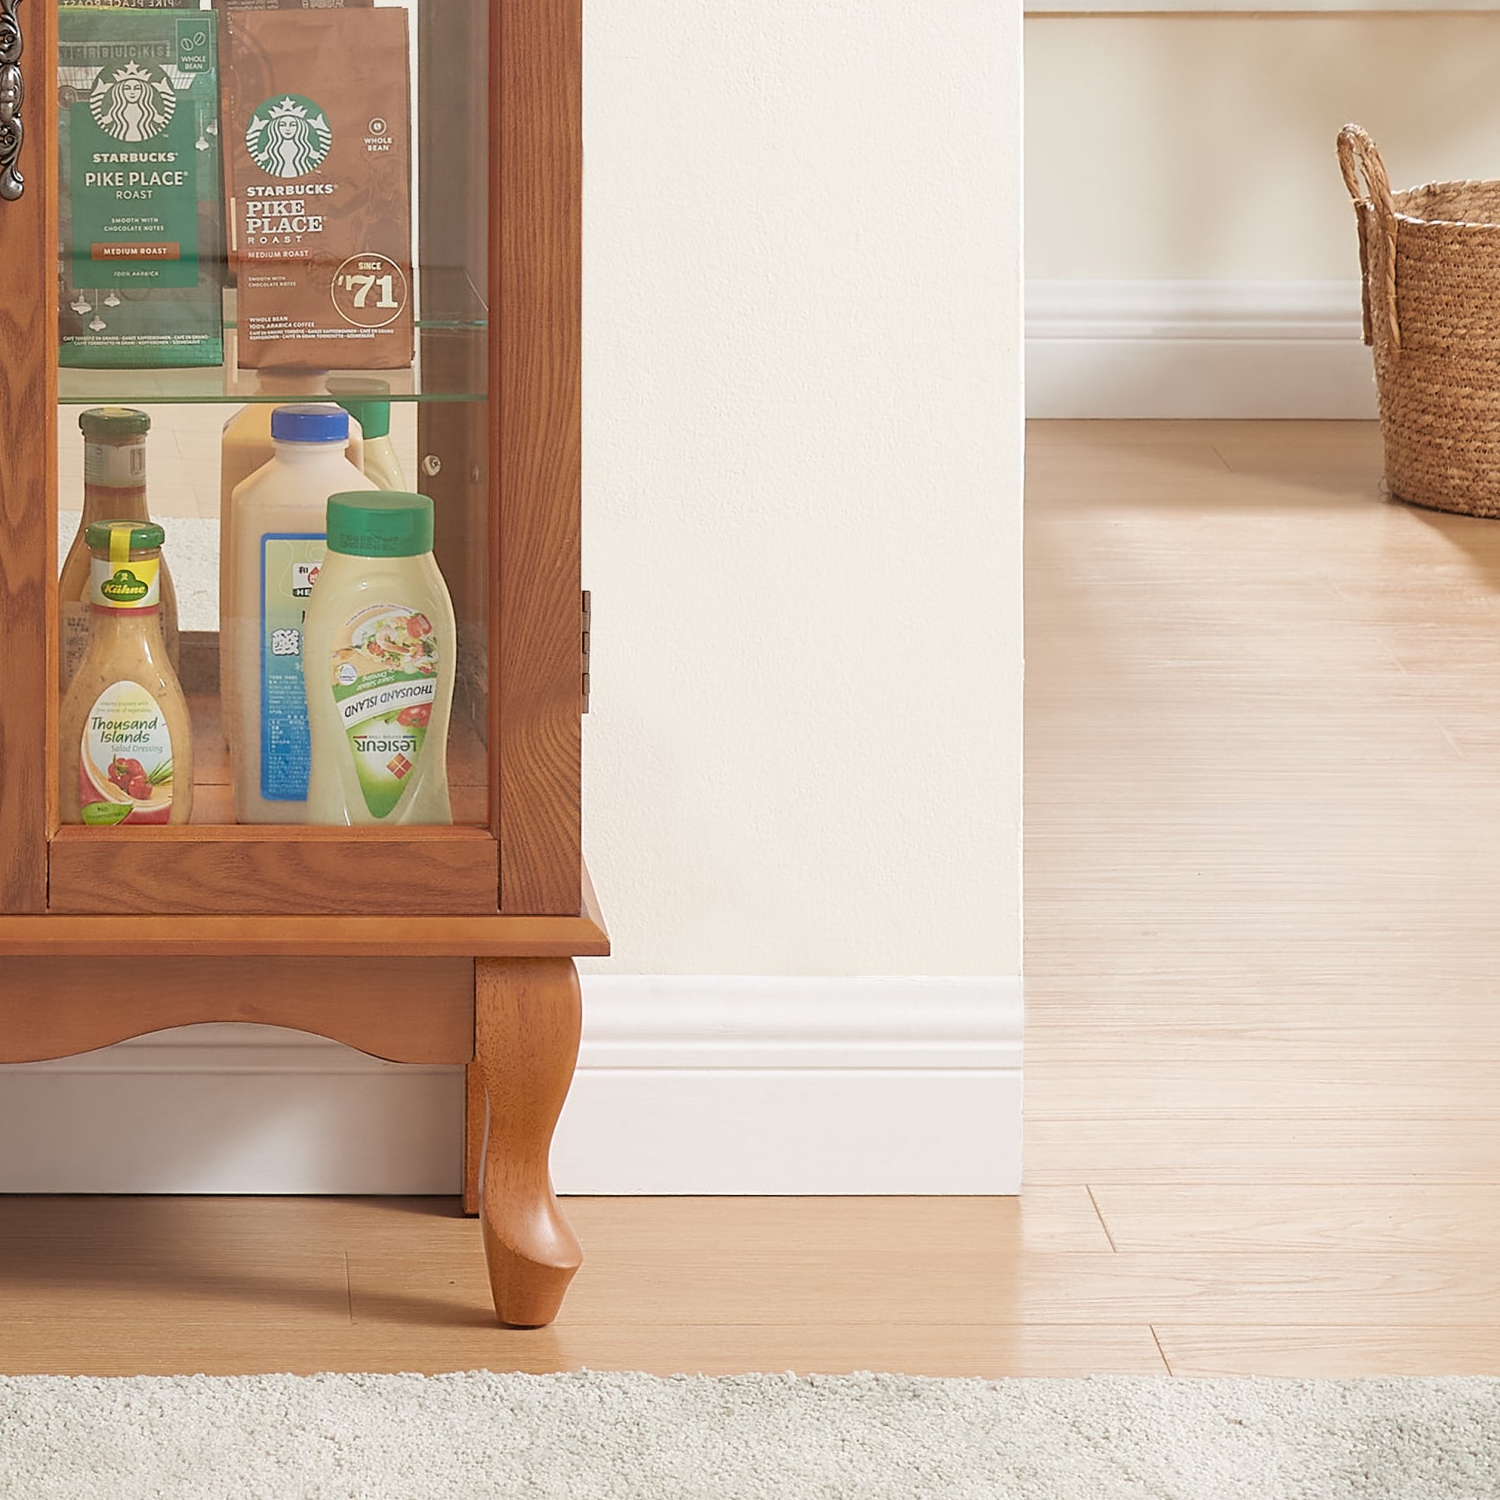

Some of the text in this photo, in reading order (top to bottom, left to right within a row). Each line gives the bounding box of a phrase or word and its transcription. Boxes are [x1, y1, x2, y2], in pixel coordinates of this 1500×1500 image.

[184, 62, 204, 70] BEAN
[363, 137, 393, 145] WHOLE
[367, 144, 389, 152] BEAN
[85, 172, 124, 187] PIKE
[116, 190, 153, 200] ROAST
[246, 199, 306, 217] PIKE
[247, 235, 302, 244] ROAST
[248, 251, 282, 259] MEDIUM
[358, 262, 382, 270] SINCE
[104, 584, 146, 595] Kühne
[272, 629, 304, 655] 酸
[344, 685, 433, 718] THOUSAND ISLAND
[91, 716, 158, 730] Thousand
[100, 730, 150, 743] Islands
[111, 744, 164, 754] Salad Dressing
